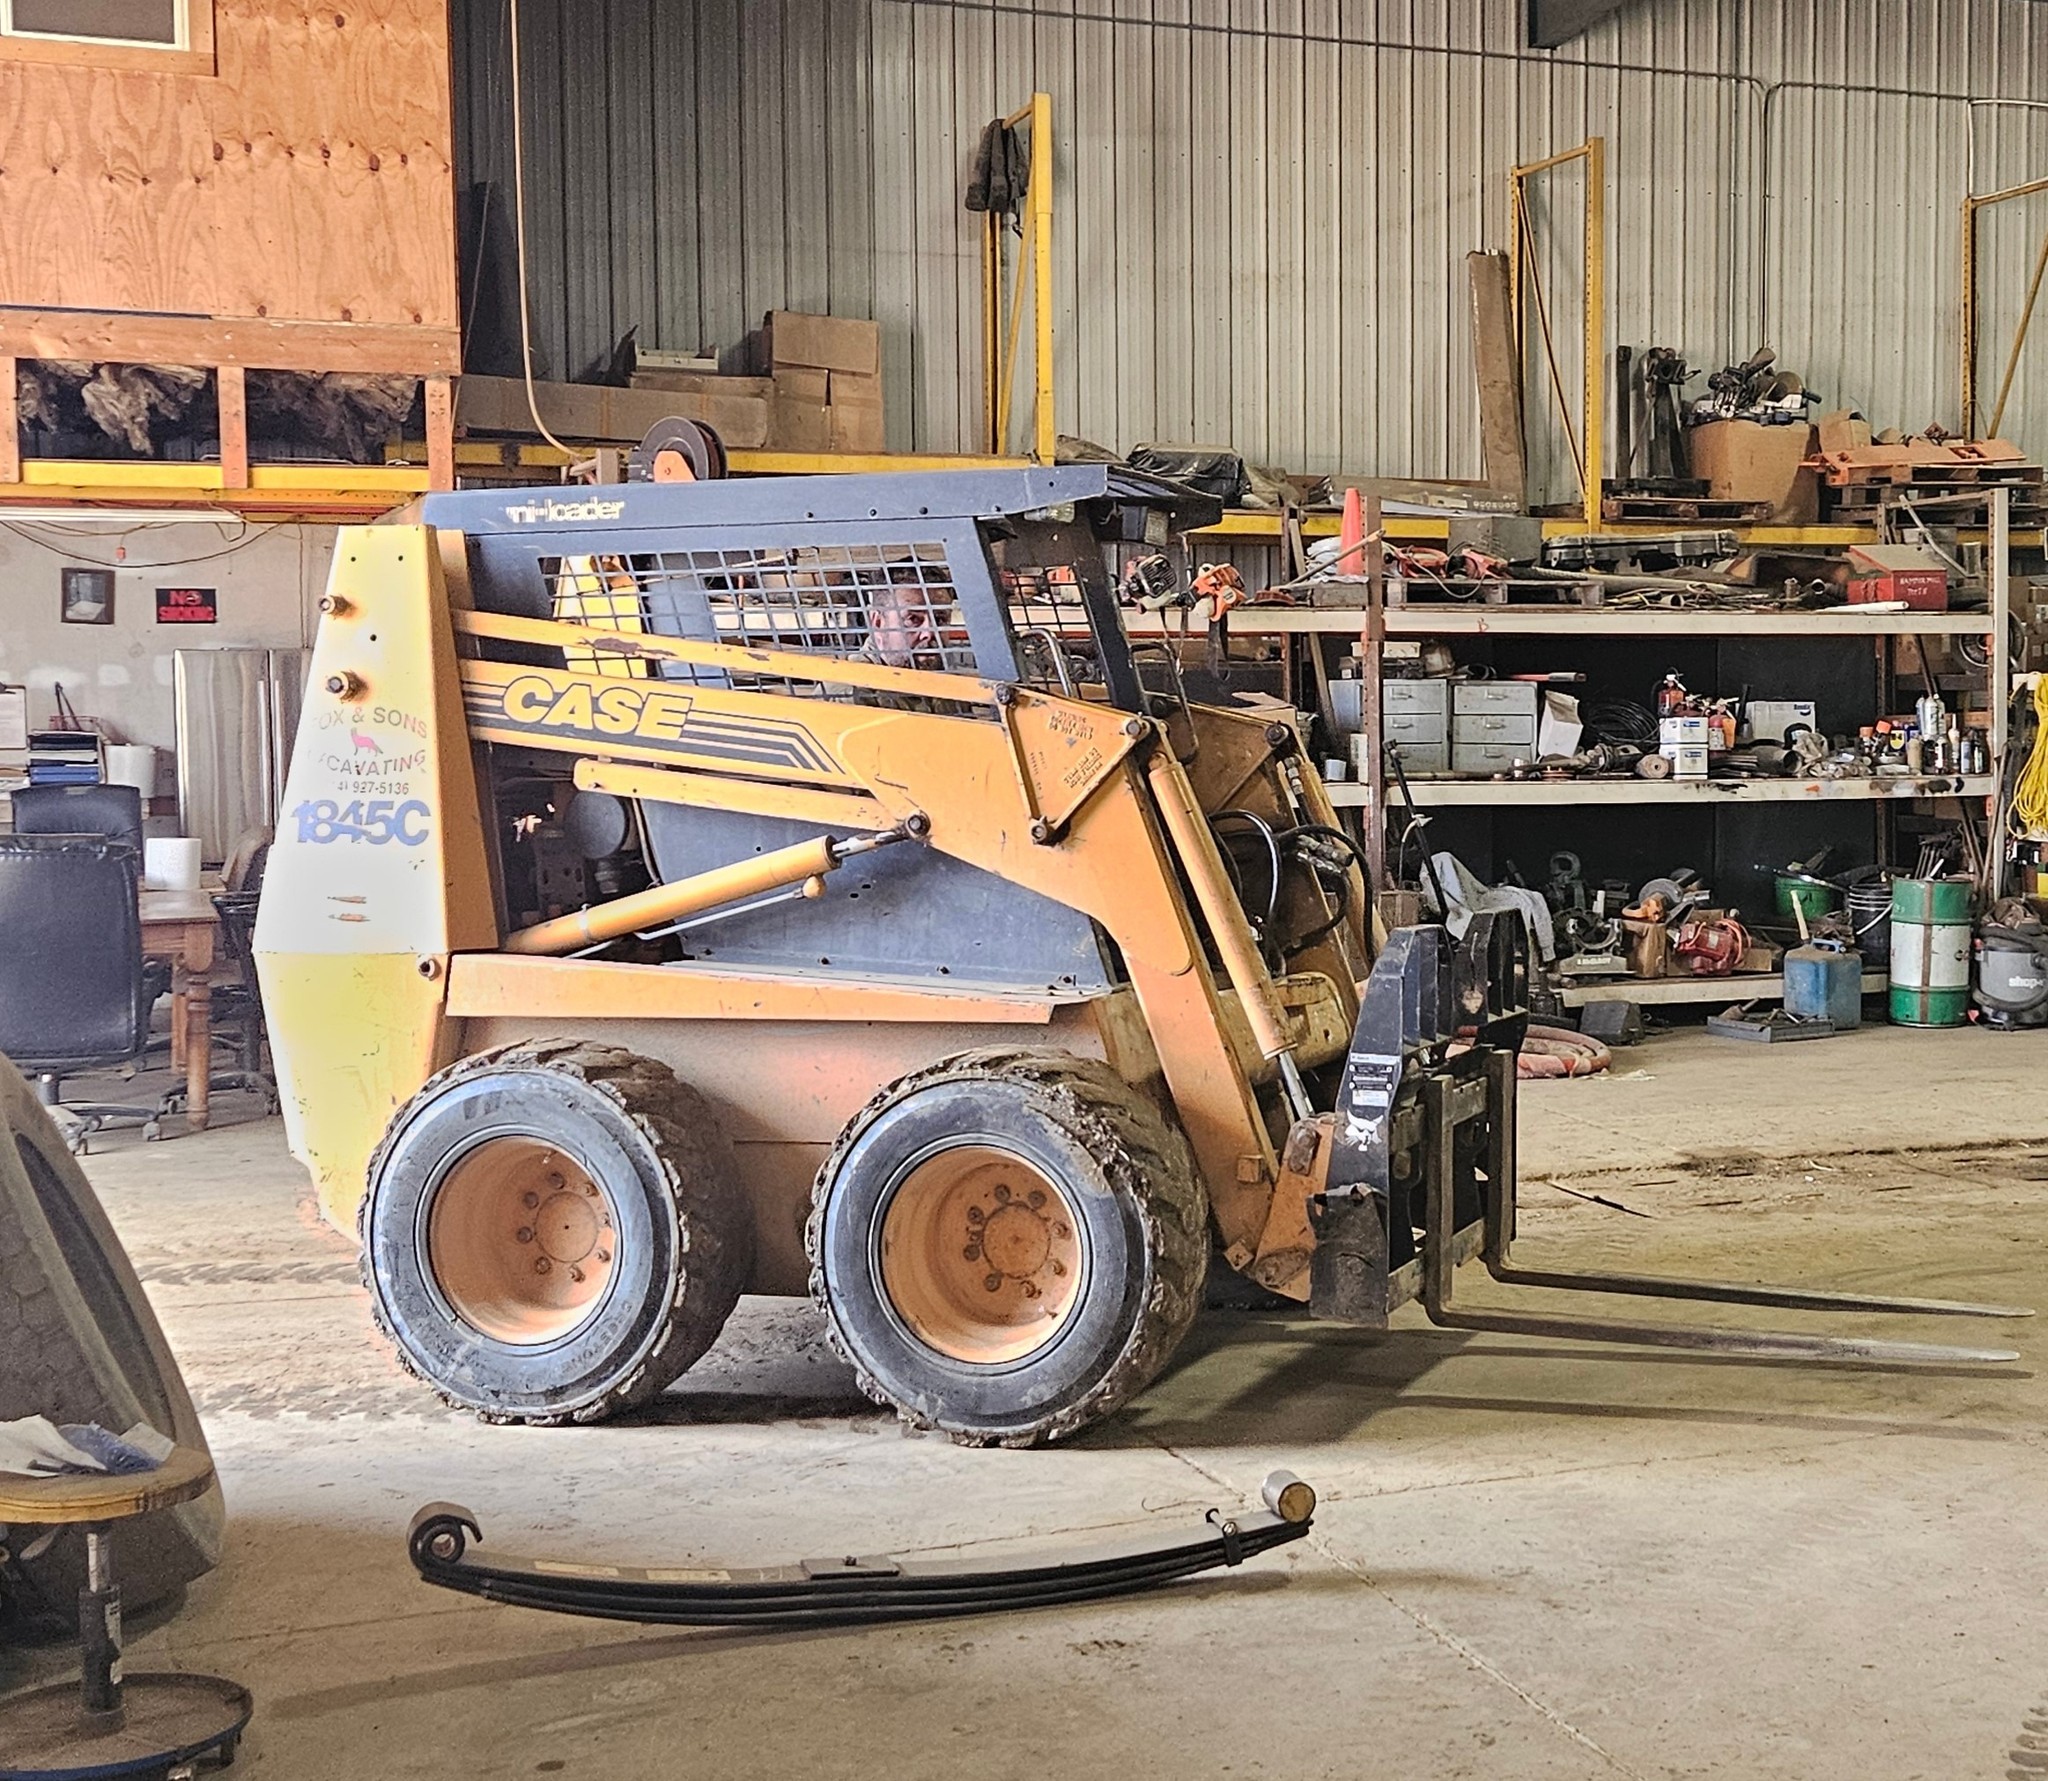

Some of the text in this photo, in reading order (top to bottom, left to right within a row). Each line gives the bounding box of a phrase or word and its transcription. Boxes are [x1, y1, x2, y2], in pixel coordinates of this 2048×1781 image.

[169, 590, 203, 606] NO
[312, 706, 427, 739] OX & SONS
[503, 675, 693, 741] CASE
[308, 749, 427, 776] CAVATING
[352, 780, 410, 796] 927-5136
[290, 799, 432, 847] 1845C
